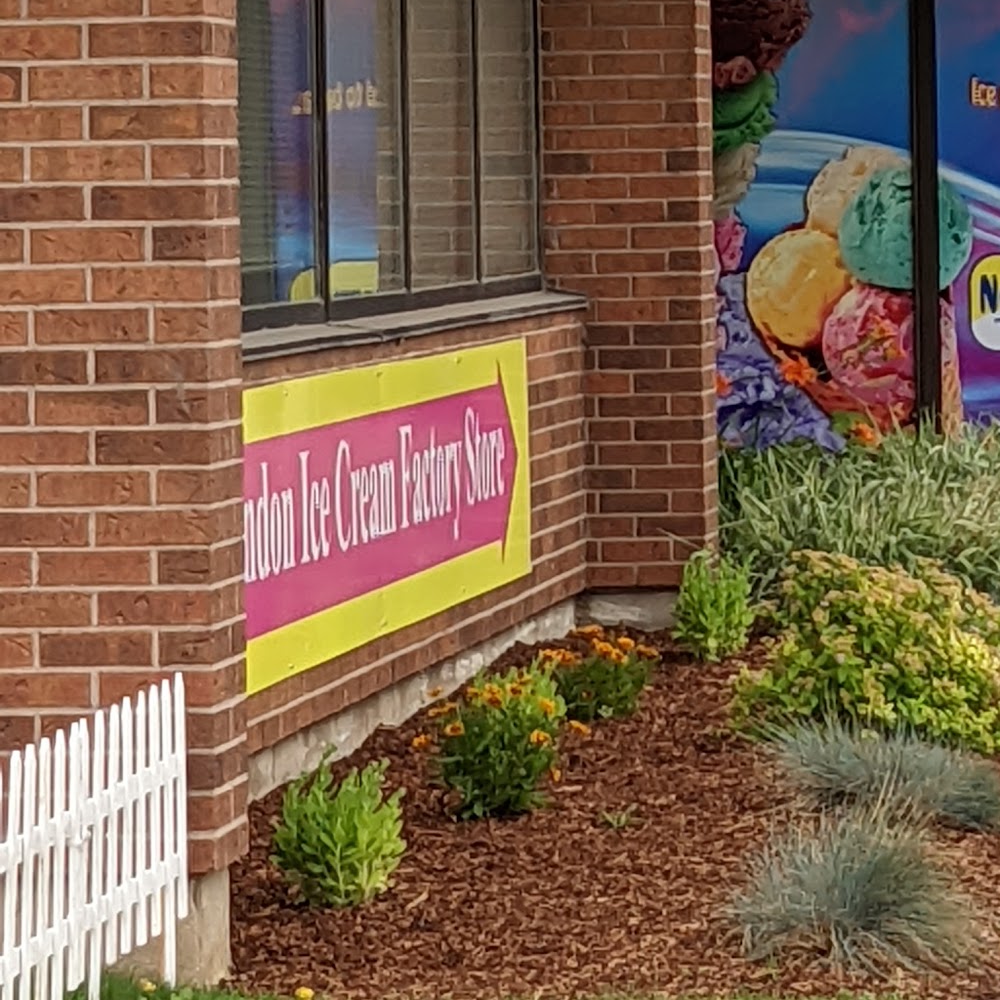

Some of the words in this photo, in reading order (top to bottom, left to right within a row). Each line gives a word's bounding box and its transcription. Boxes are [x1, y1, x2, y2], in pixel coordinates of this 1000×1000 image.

[970, 76, 997, 107] Ice
[299, 450, 330, 564] Ice
[335, 439, 397, 552] Cream
[398, 424, 463, 541] Factory
[465, 406, 506, 506] Store
